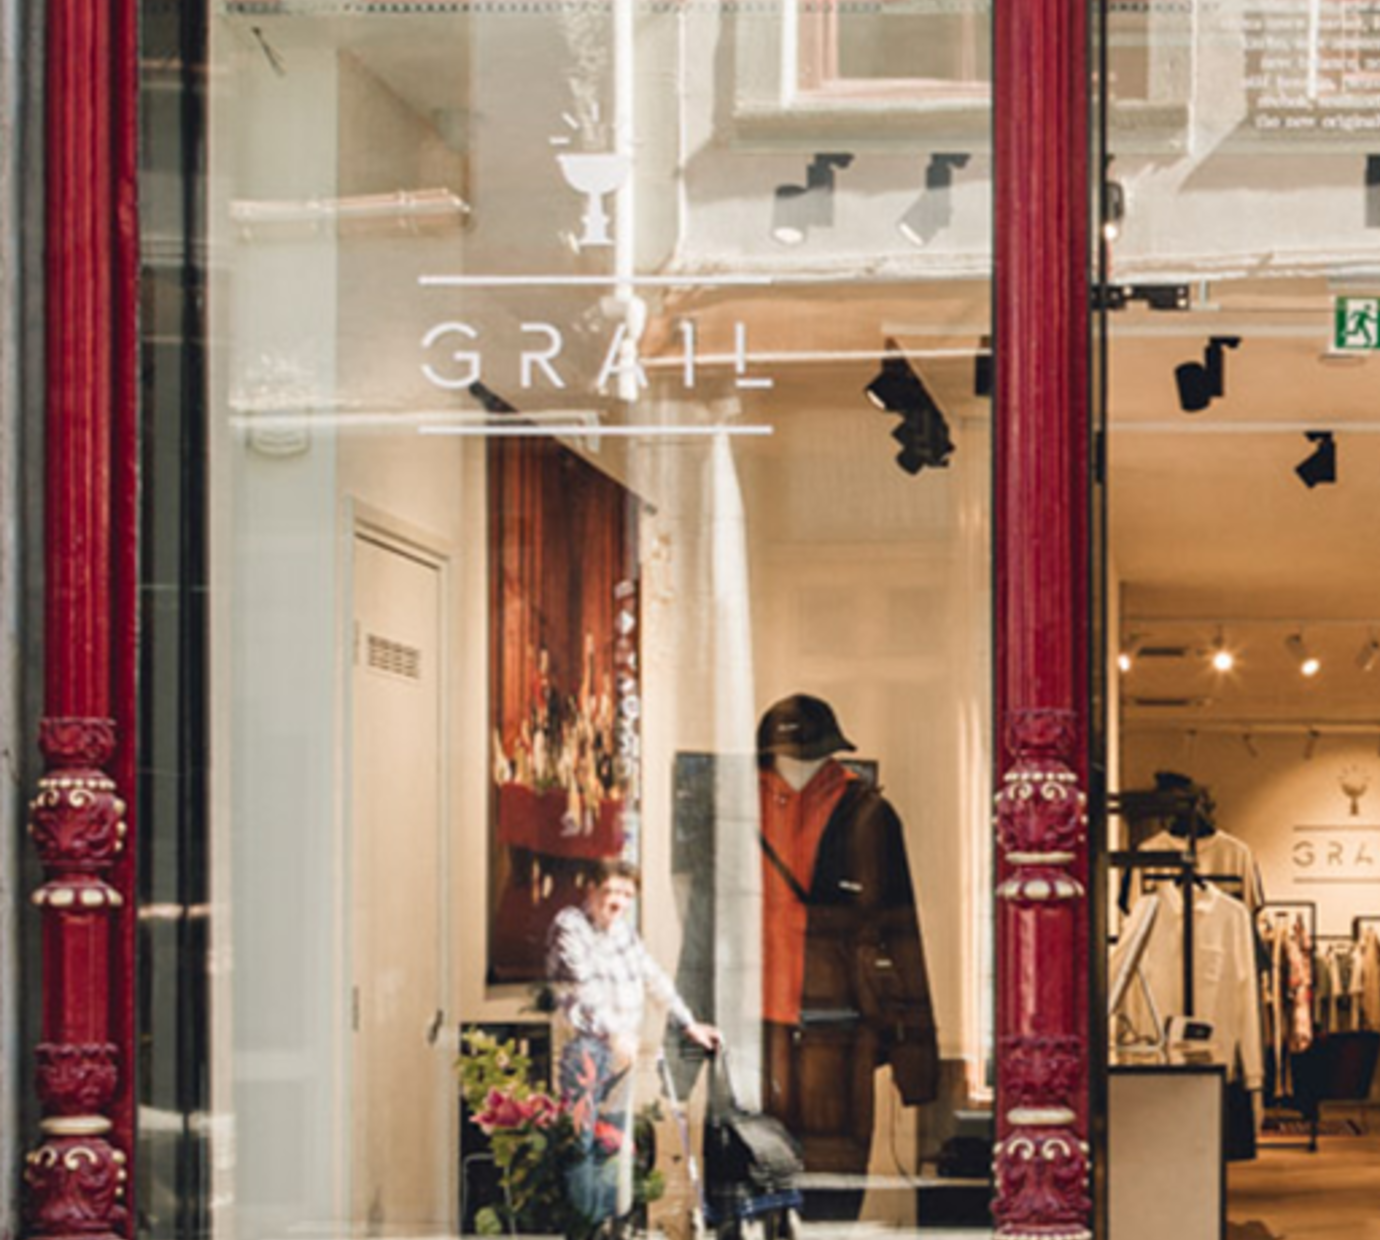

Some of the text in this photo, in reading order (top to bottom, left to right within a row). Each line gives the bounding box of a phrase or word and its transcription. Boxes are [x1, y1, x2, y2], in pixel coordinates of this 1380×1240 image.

[1255, 113, 1282, 128] the
[1284, 116, 1317, 128] new
[421, 322, 774, 389] GRAIL
